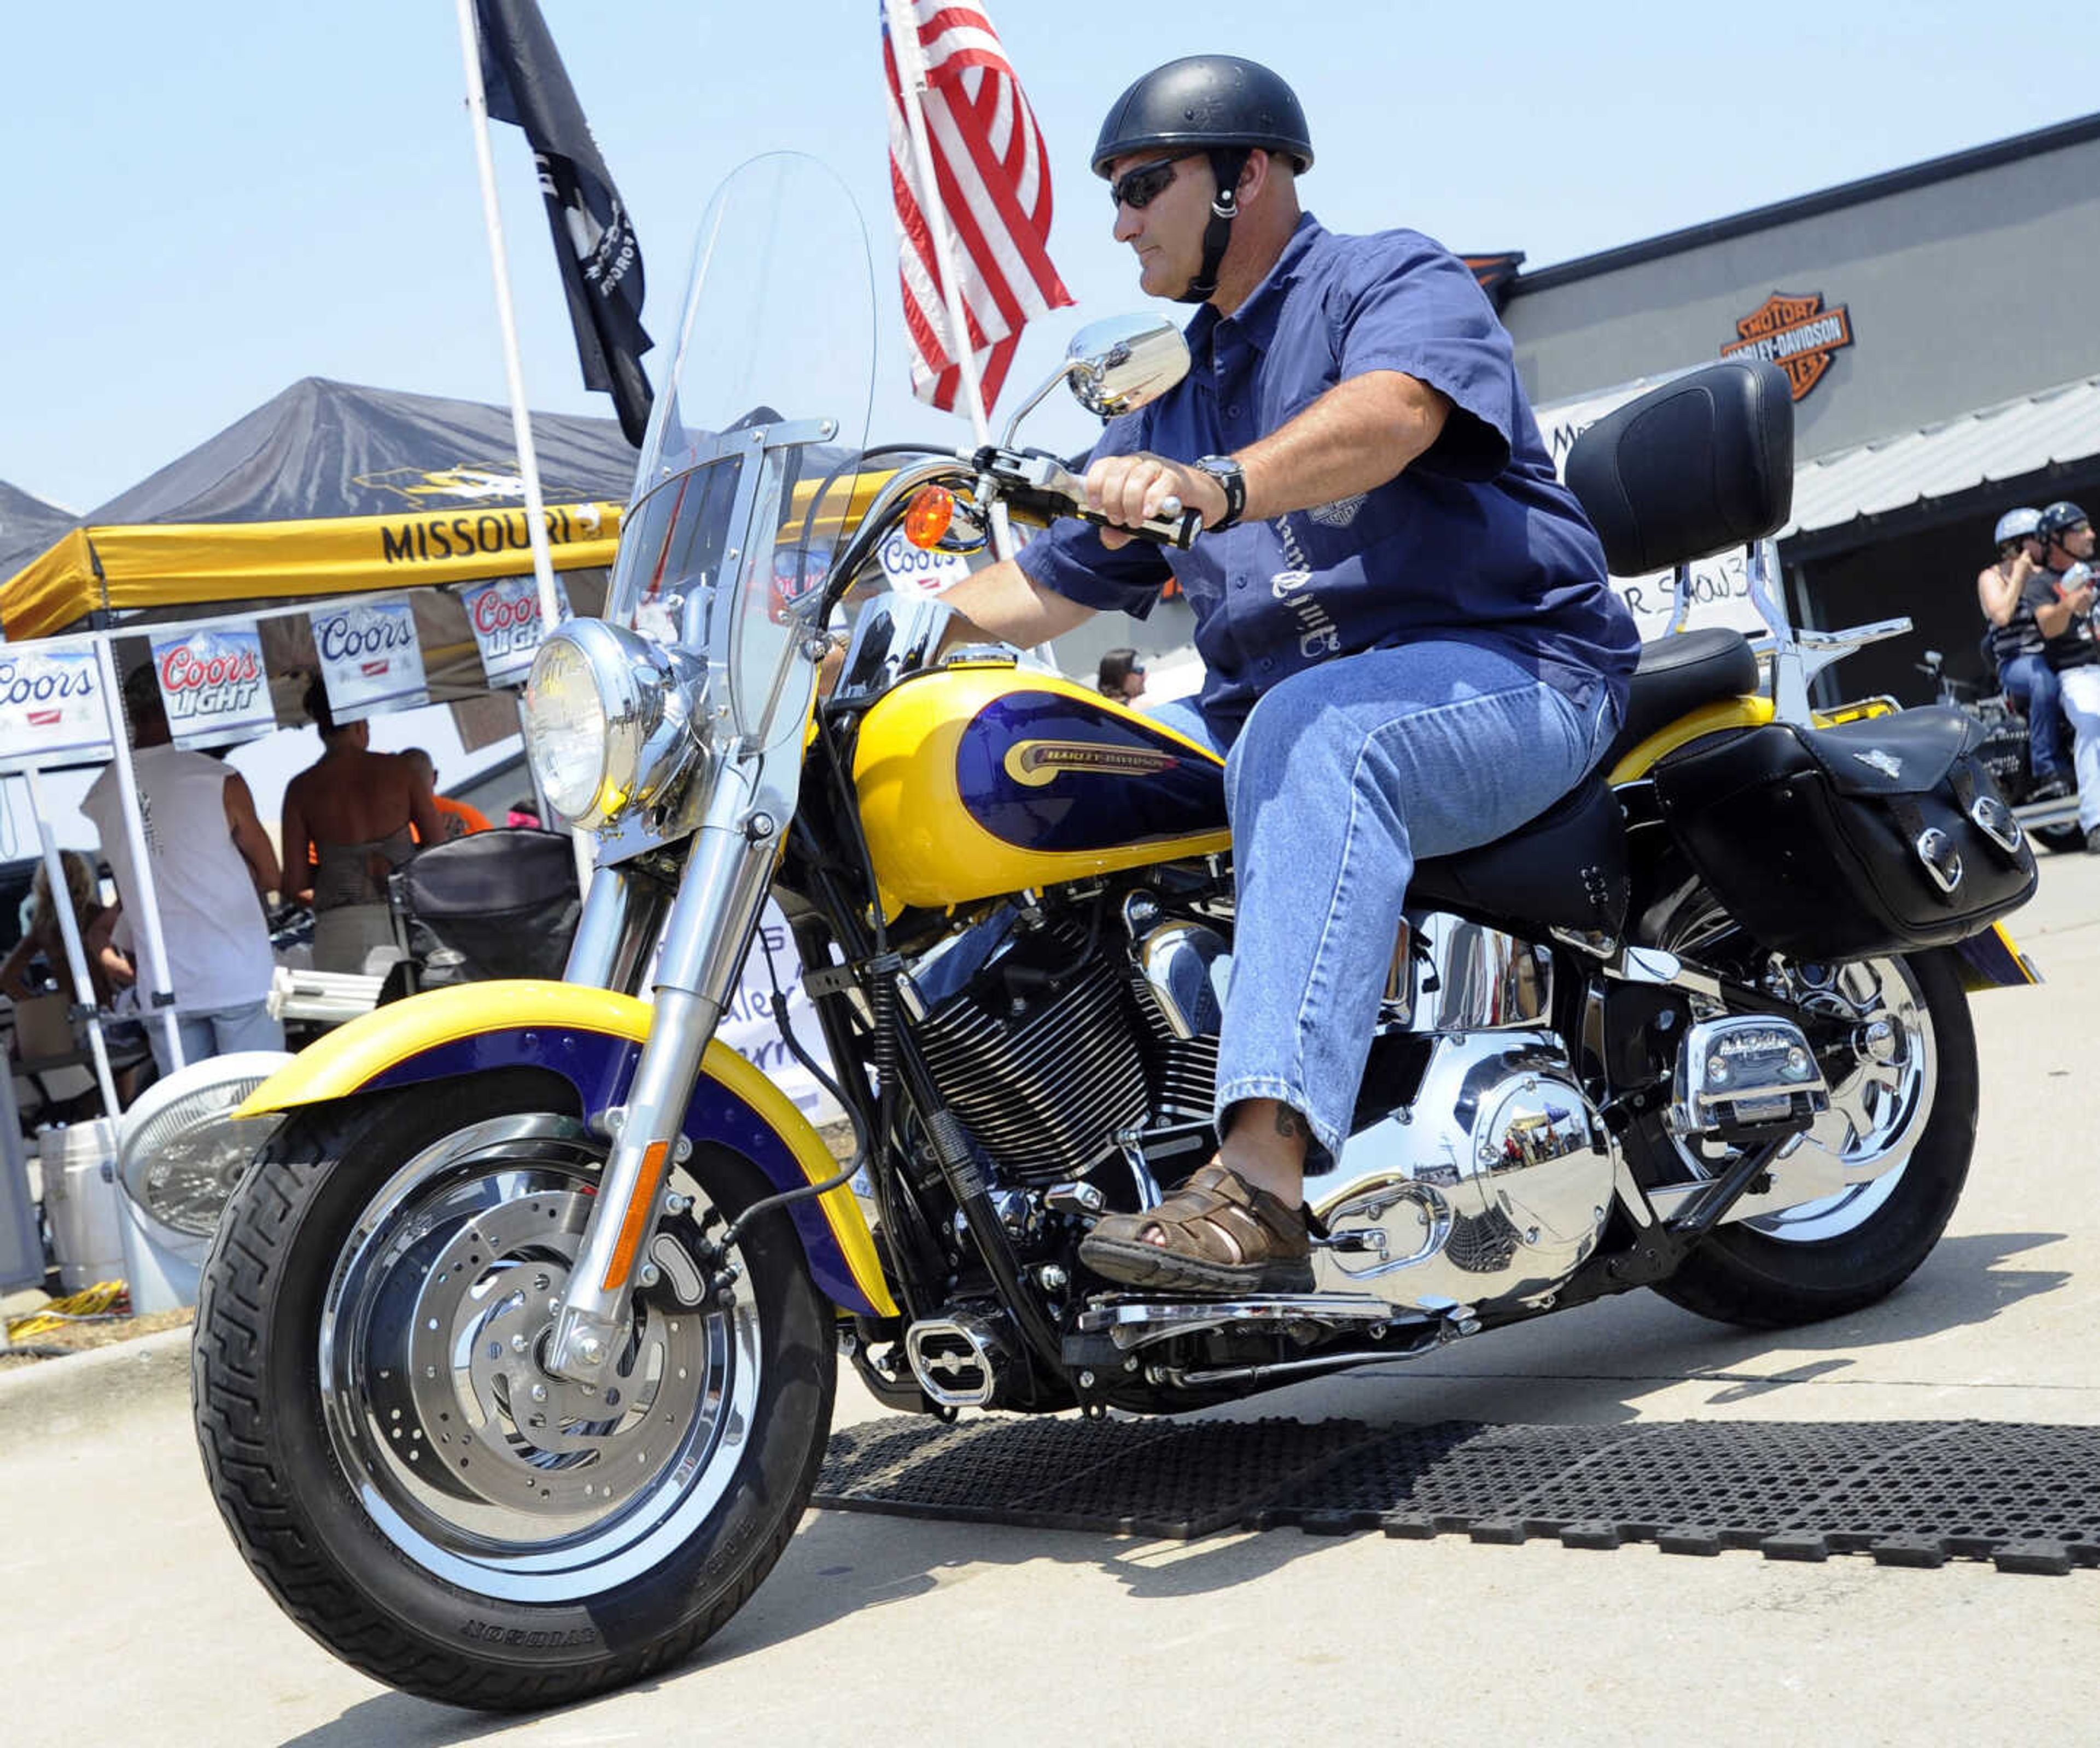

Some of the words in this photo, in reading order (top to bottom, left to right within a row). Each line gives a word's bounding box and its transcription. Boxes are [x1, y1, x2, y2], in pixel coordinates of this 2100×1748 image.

[381, 508, 571, 563] MISSOURI
[319, 617, 411, 661] Coors
[160, 645, 257, 692] Coors
[171, 683, 259, 720] LIGHT
